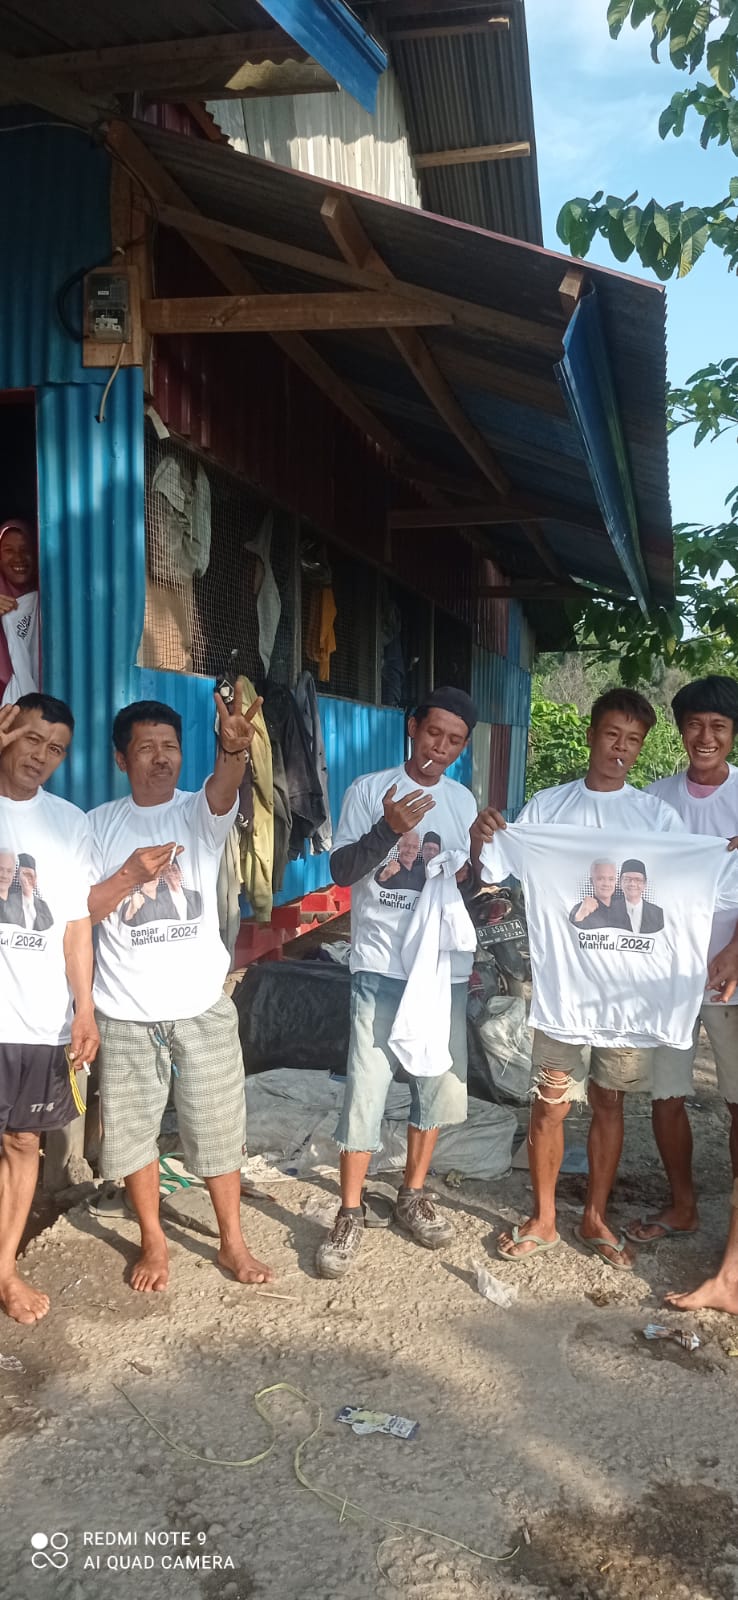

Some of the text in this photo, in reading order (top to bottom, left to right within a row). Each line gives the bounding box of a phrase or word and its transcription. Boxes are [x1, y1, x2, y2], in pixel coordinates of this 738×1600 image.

[379, 890, 408, 902] Ganjar
[378, 898, 412, 910] Mahfud
[130, 926, 159, 938] Ganjar
[131, 925, 198, 947] Mahfud 2024
[578, 931, 610, 942] Ganjar
[14, 934, 43, 949] 2024
[579, 937, 651, 951] Mahfud 2024
